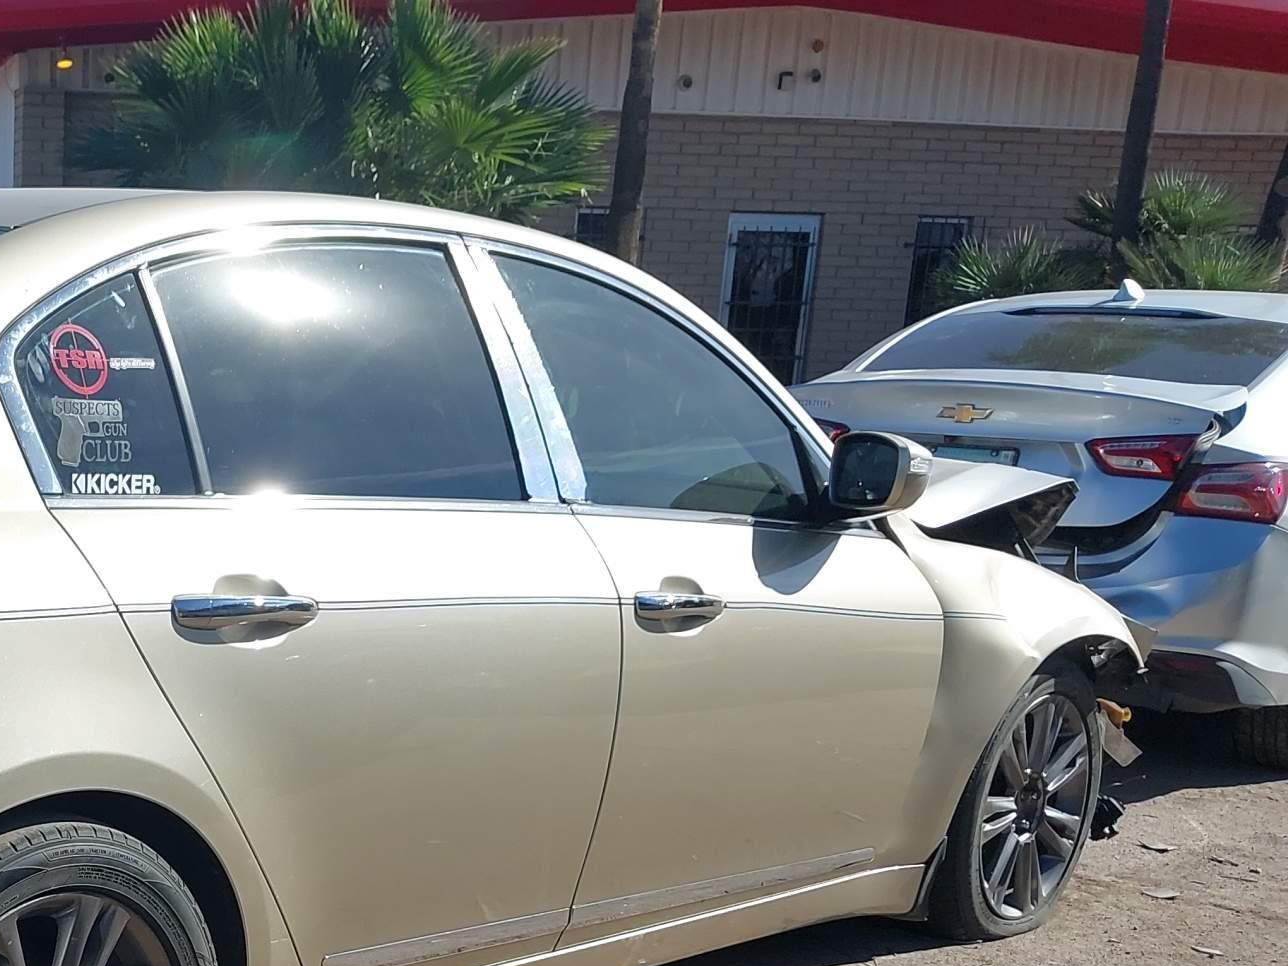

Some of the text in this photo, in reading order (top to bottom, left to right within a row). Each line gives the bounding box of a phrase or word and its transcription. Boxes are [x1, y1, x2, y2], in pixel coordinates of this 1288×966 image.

[53, 348, 105, 370] TSR
[55, 400, 121, 418] SUSPECTS
[103, 423, 128, 437] GUN
[82, 439, 133, 462] CLUB
